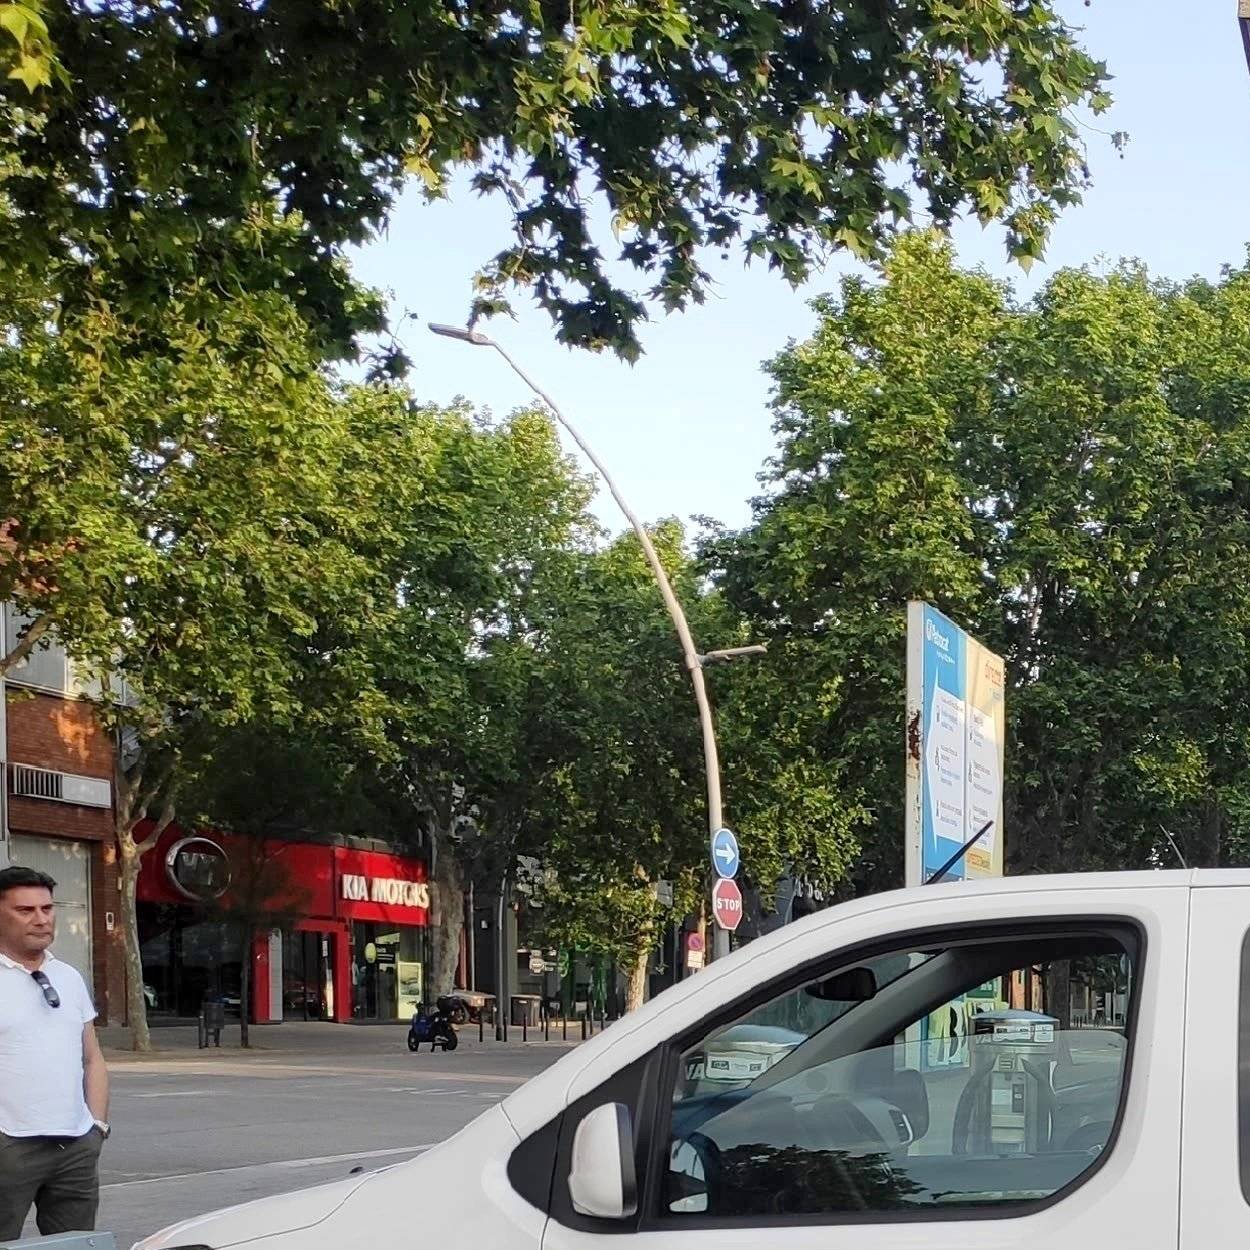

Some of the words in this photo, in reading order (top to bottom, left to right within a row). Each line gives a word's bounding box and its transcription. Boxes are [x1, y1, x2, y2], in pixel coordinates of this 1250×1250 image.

[342, 873, 369, 901] KIA
[371, 877, 430, 908] MOTORS
[717, 898, 740, 911] STOP
